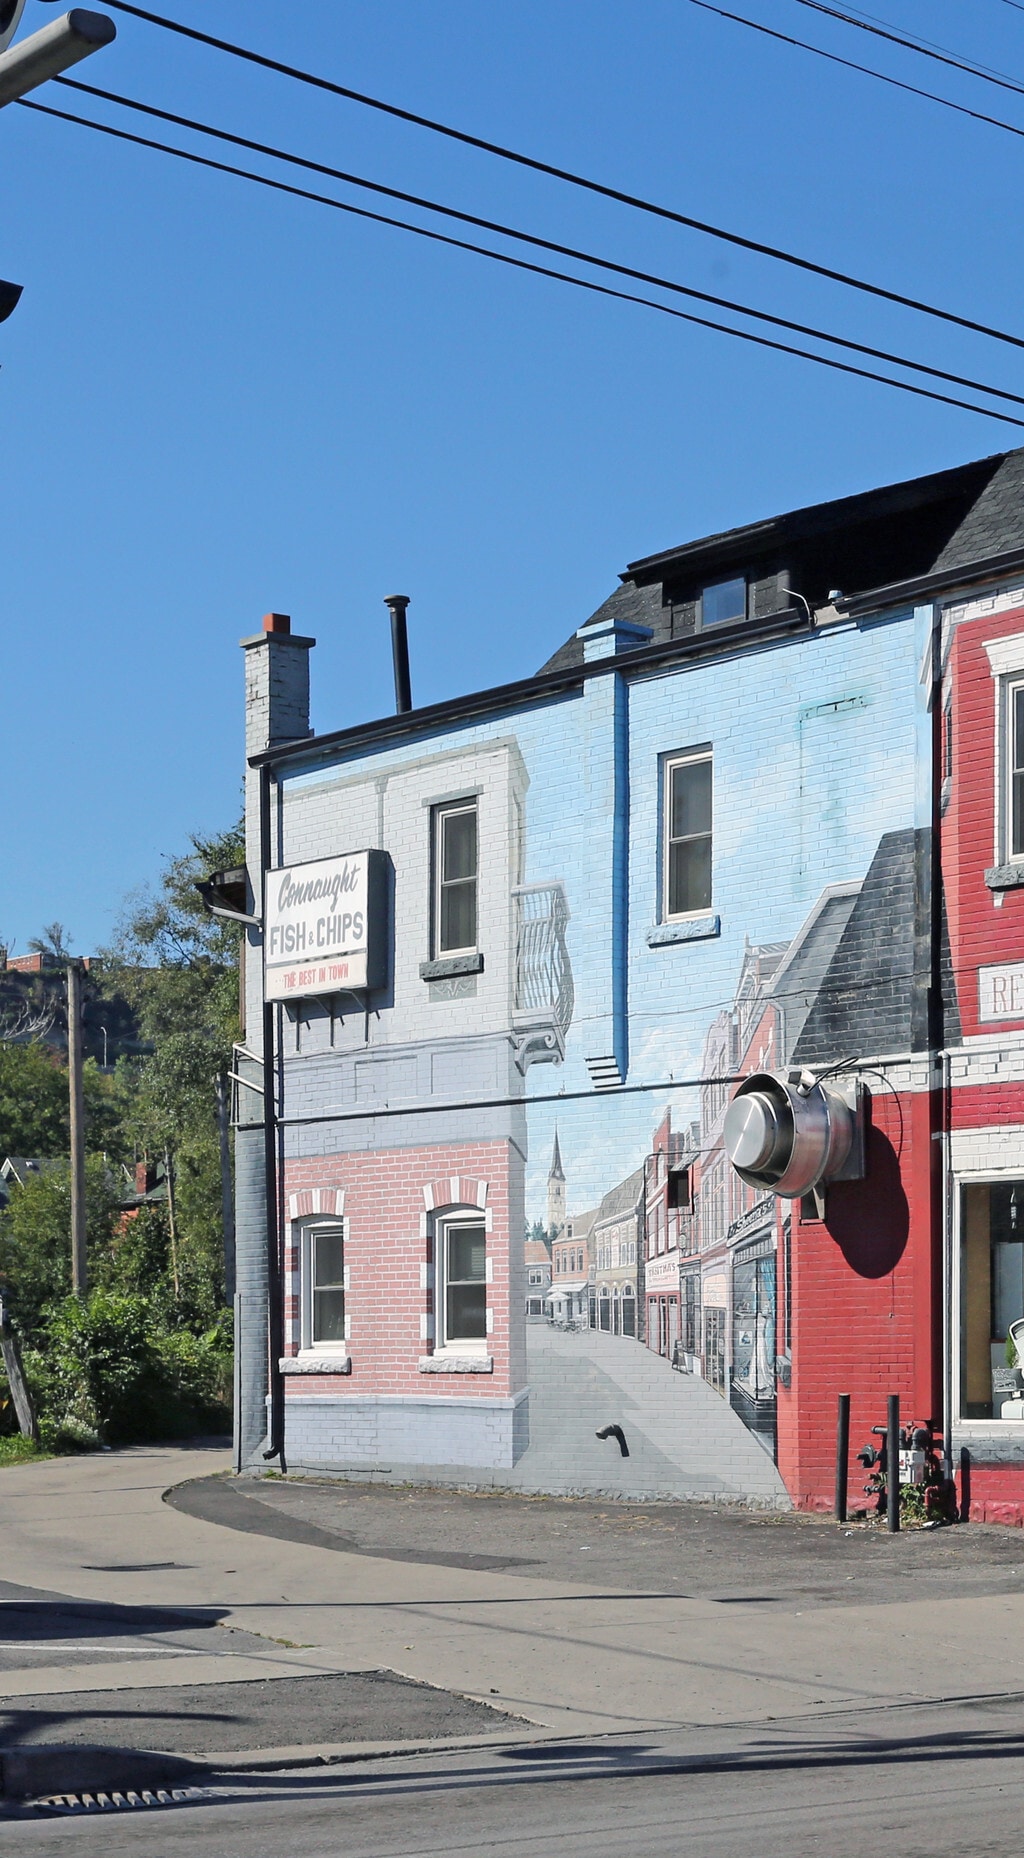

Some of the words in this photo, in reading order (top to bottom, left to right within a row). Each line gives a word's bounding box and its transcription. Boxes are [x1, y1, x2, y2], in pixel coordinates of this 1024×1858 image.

[278, 861, 361, 913] Connaught
[270, 921, 306, 956] FISH
[308, 930, 314, 946] &
[316, 911, 364, 948] CHIPS
[283, 971, 296, 989] THE
[299, 968, 317, 987] BEST
[319, 967, 326, 984] IN
[328, 963, 349, 980] TOWN
